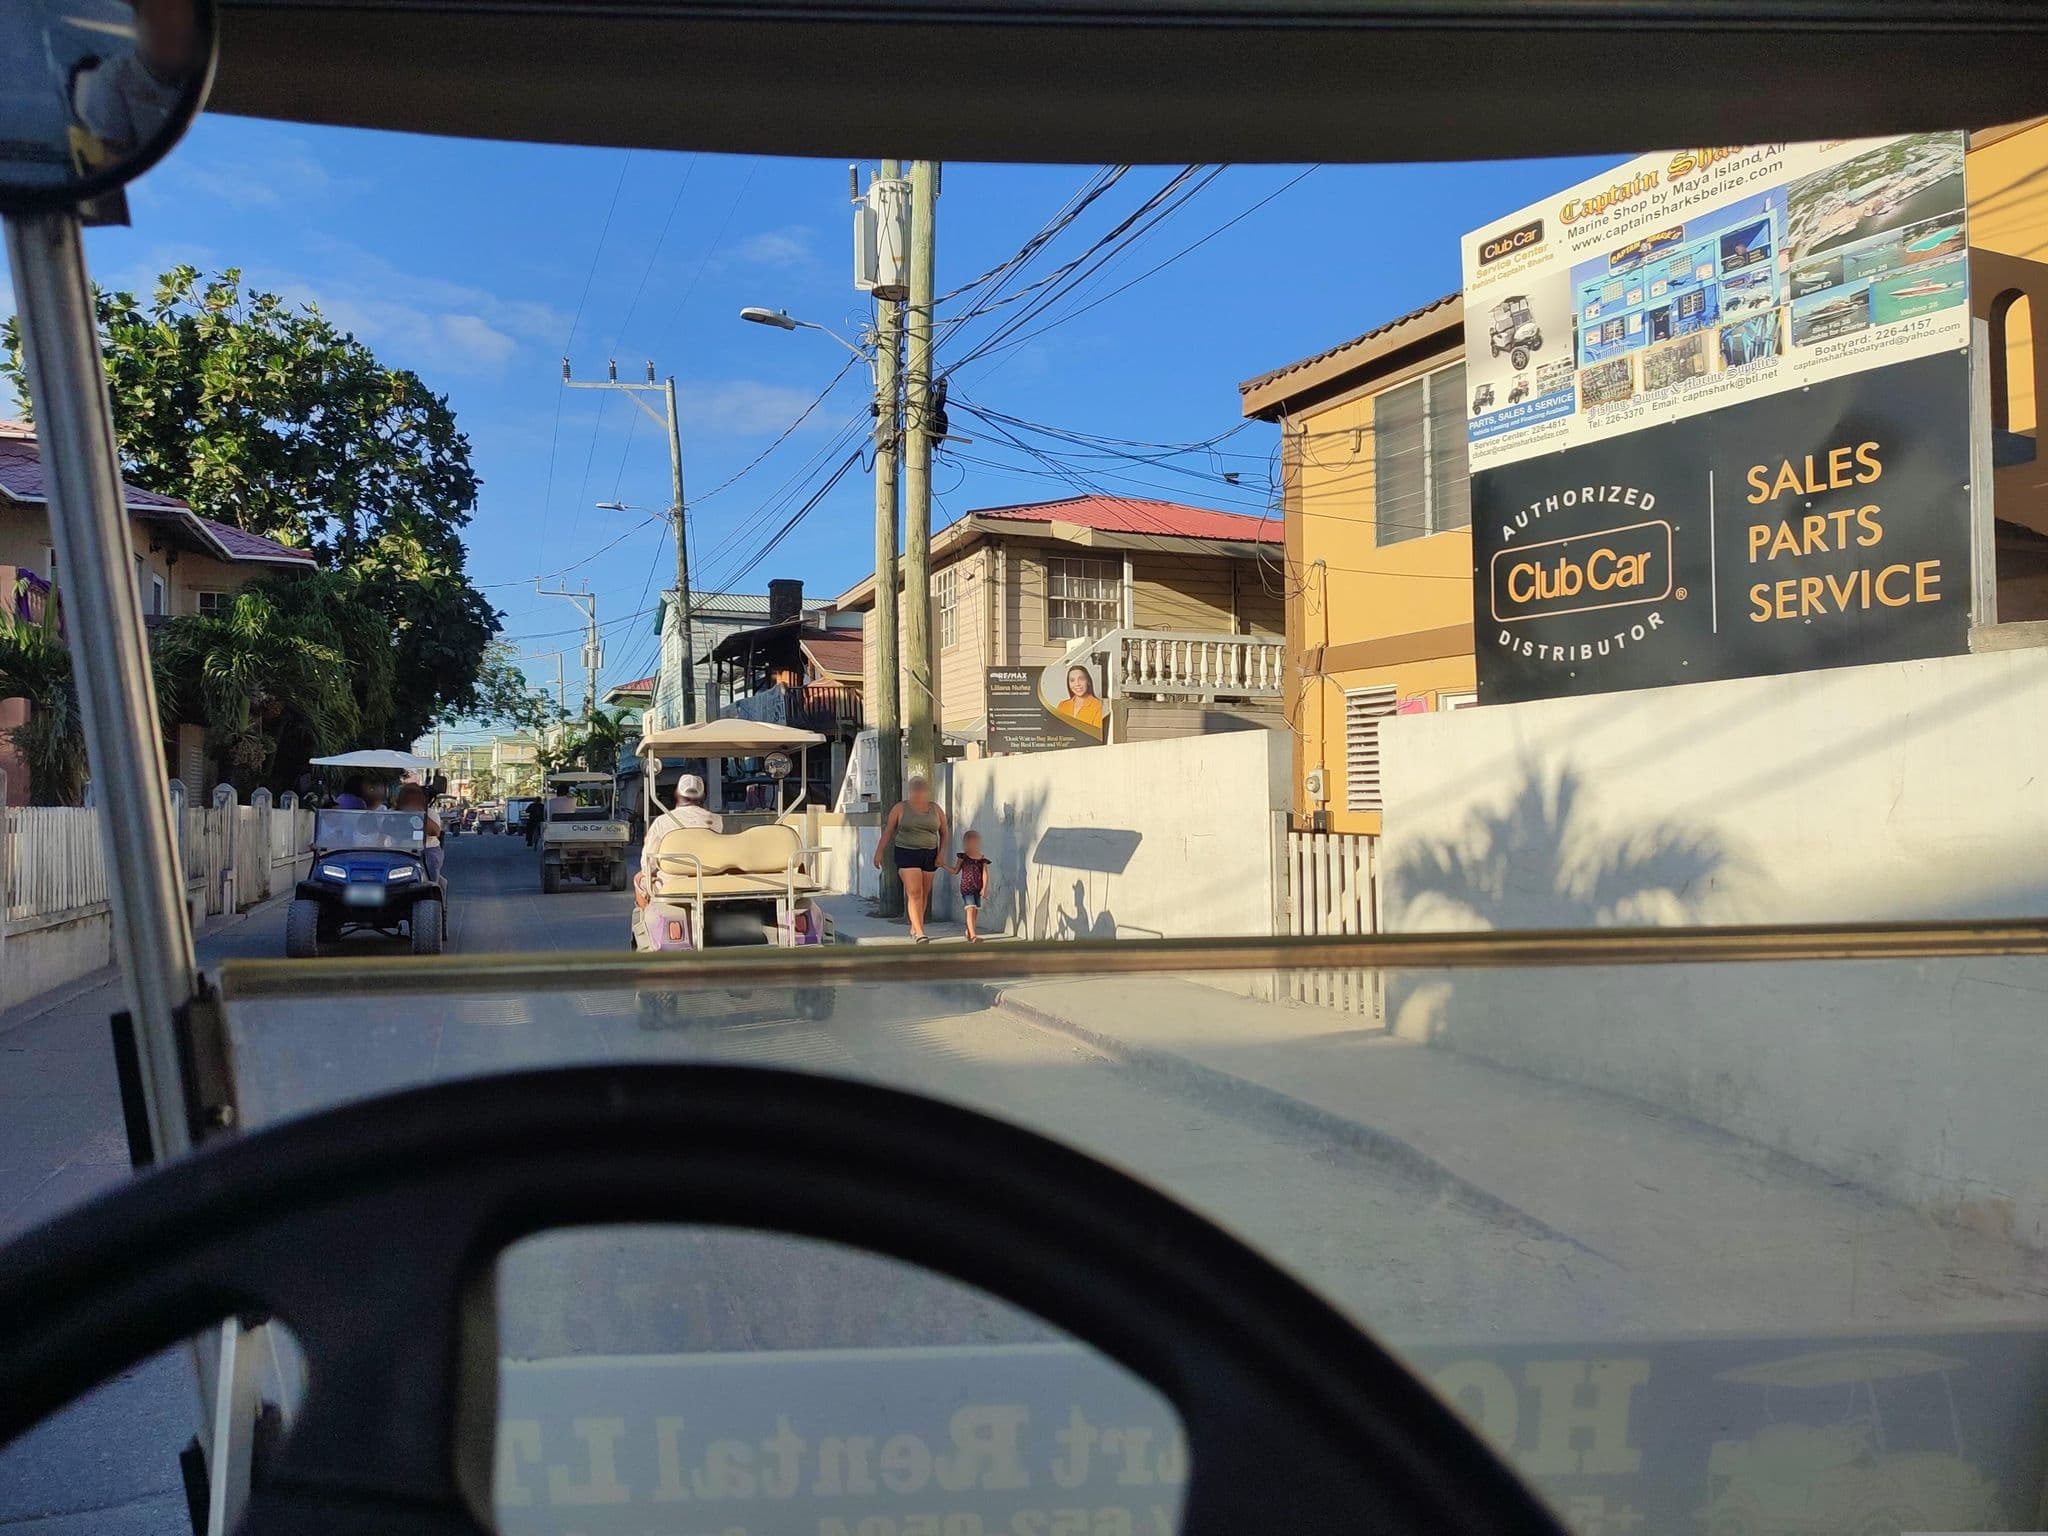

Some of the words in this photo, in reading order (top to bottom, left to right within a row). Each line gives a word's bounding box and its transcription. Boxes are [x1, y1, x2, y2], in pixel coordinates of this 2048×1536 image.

[1560, 169, 1660, 225] Captain
[1567, 216, 1610, 240] Marine
[1613, 199, 1648, 221] Shop
[1651, 190, 1669, 205] by
[1672, 173, 1710, 196] Maya
[1714, 150, 1760, 179] Island
[1764, 142, 1787, 159] Air
[1571, 160, 1783, 252] www.captainsharksbelize.com
[1472, 273, 1497, 291] Behind
[1497, 264, 1526, 280] Captain
[1527, 252, 1554, 268] Sharks
[1476, 258, 1512, 279] Service
[1514, 243, 1549, 263] Center
[1792, 321, 1962, 371] captainsharksboatyard@yahoo.com
[1814, 333, 1872, 356] Boatyard:
[1875, 318, 1933, 341] 226-4157
[1727, 354, 1780, 380] Supplies
[1468, 415, 1497, 431] PARTS,
[1498, 406, 1526, 422] SALES
[1526, 404, 1533, 413] &
[1535, 392, 1574, 411] SERVICE
[1588, 419, 1603, 430] Tel:
[1605, 406, 1645, 425] 226-3370
[1652, 396, 1680, 411] Email:
[1682, 369, 1778, 402] captnshark@btl.net
[1474, 438, 1500, 450] Service
[1501, 430, 1530, 443] Center:
[1746, 440, 1884, 505] SALES
[1501, 484, 1657, 542] AUTHORIZED
[1748, 504, 1884, 564] PARTS
[1748, 558, 1943, 624] SERVICE
[1497, 610, 1666, 662] DISTRIBUTOR
[571, 824, 588, 832] Club
[590, 824, 602, 832] Car
